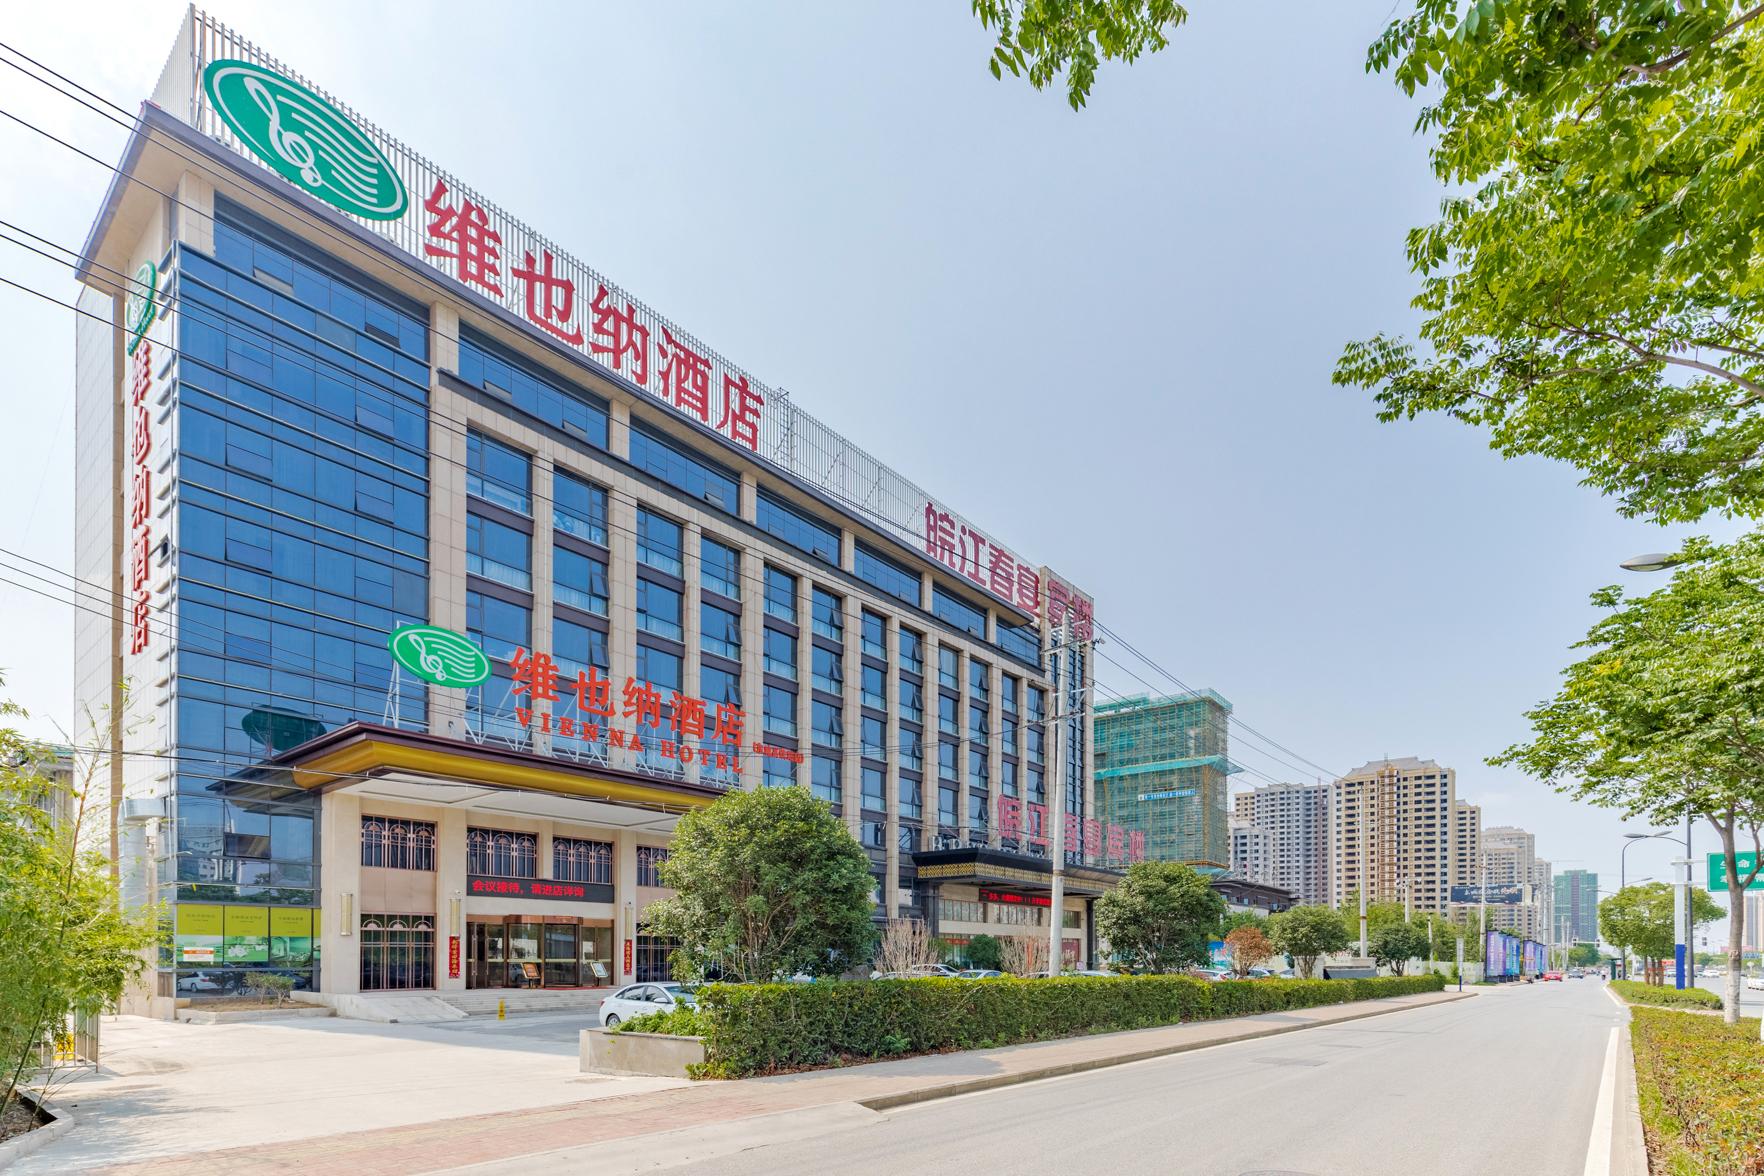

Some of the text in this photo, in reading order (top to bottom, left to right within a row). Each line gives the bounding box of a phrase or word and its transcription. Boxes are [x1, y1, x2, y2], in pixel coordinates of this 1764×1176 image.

[424, 179, 764, 452] 维也纳酒店
[509, 646, 747, 748] 维也纳酒店
[515, 707, 644, 752] VIENNA
[660, 740, 744, 774] HOTEL
